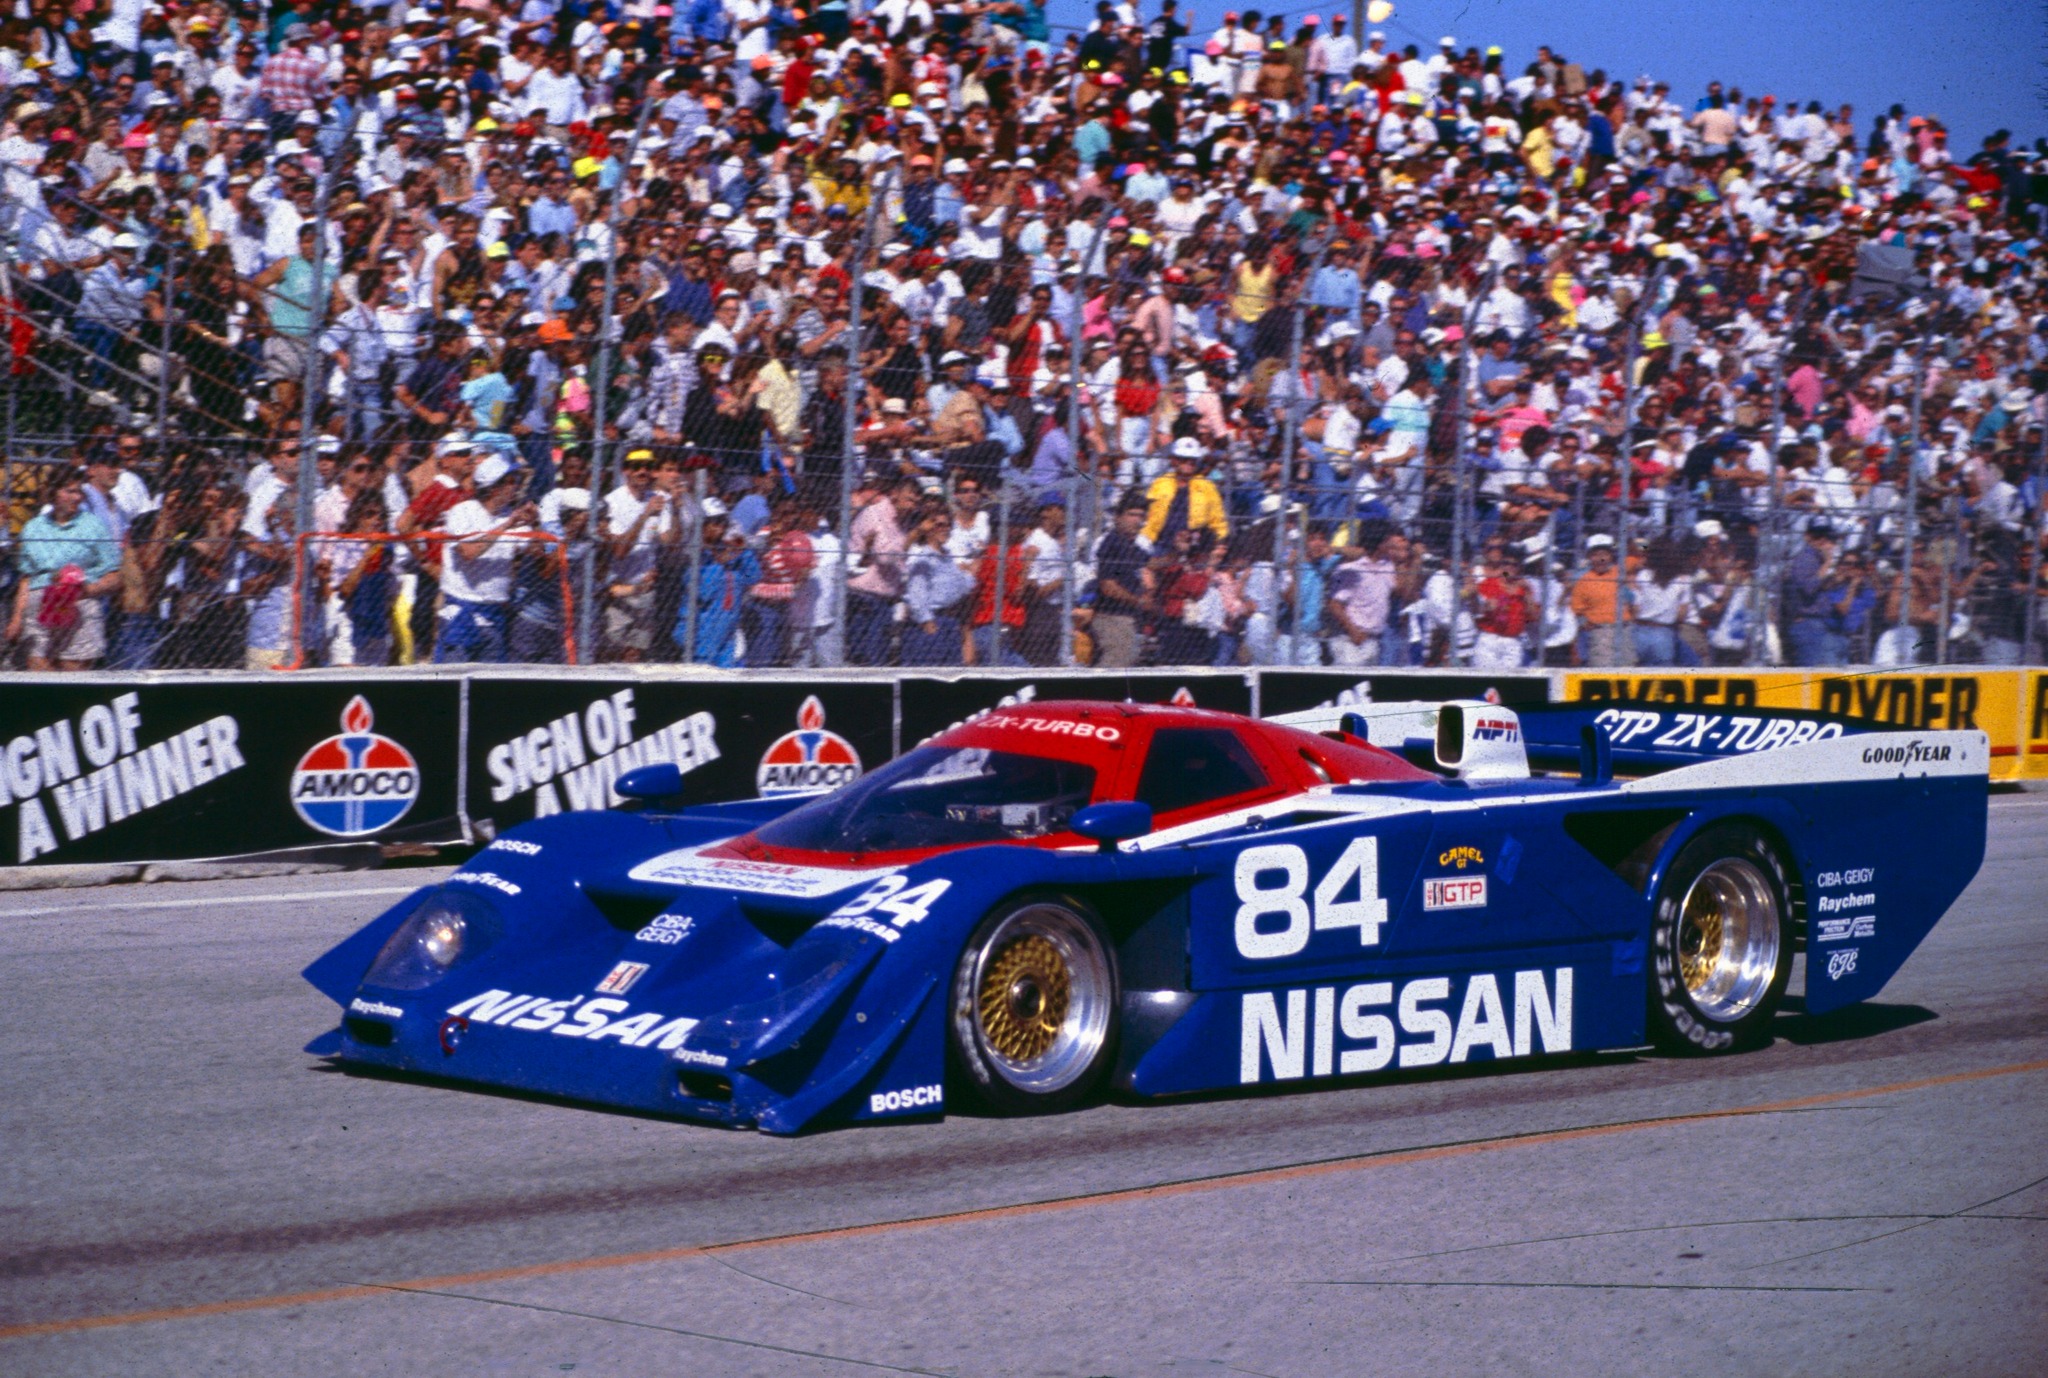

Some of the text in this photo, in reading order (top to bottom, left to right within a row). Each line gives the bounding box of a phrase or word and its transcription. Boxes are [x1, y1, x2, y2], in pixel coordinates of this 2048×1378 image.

[80, 691, 141, 767] OF
[487, 688, 637, 801] SIGN OF
[1862, 739, 1952, 769] GOODYEAR
[18, 715, 246, 864] A WINNER
[298, 770, 415, 799] AMOCO
[766, 764, 857, 787] AMOCO
[535, 782, 562, 819] A
[488, 839, 543, 856] BOSCH
[1439, 846, 1484, 866] CAMEL
[1445, 881, 1483, 903] GTP
[1817, 867, 1875, 888] CIBA-GEIGY
[830, 875, 953, 928] 84
[1234, 836, 1388, 958] 84
[1818, 892, 1876, 913] Raychem
[635, 926, 690, 944] GEIGY
[651, 914, 696, 930] CIBA-
[446, 989, 700, 1049] NISSAN
[1240, 966, 1573, 1084] NISSAN
[870, 1084, 943, 1112] BOSCH
